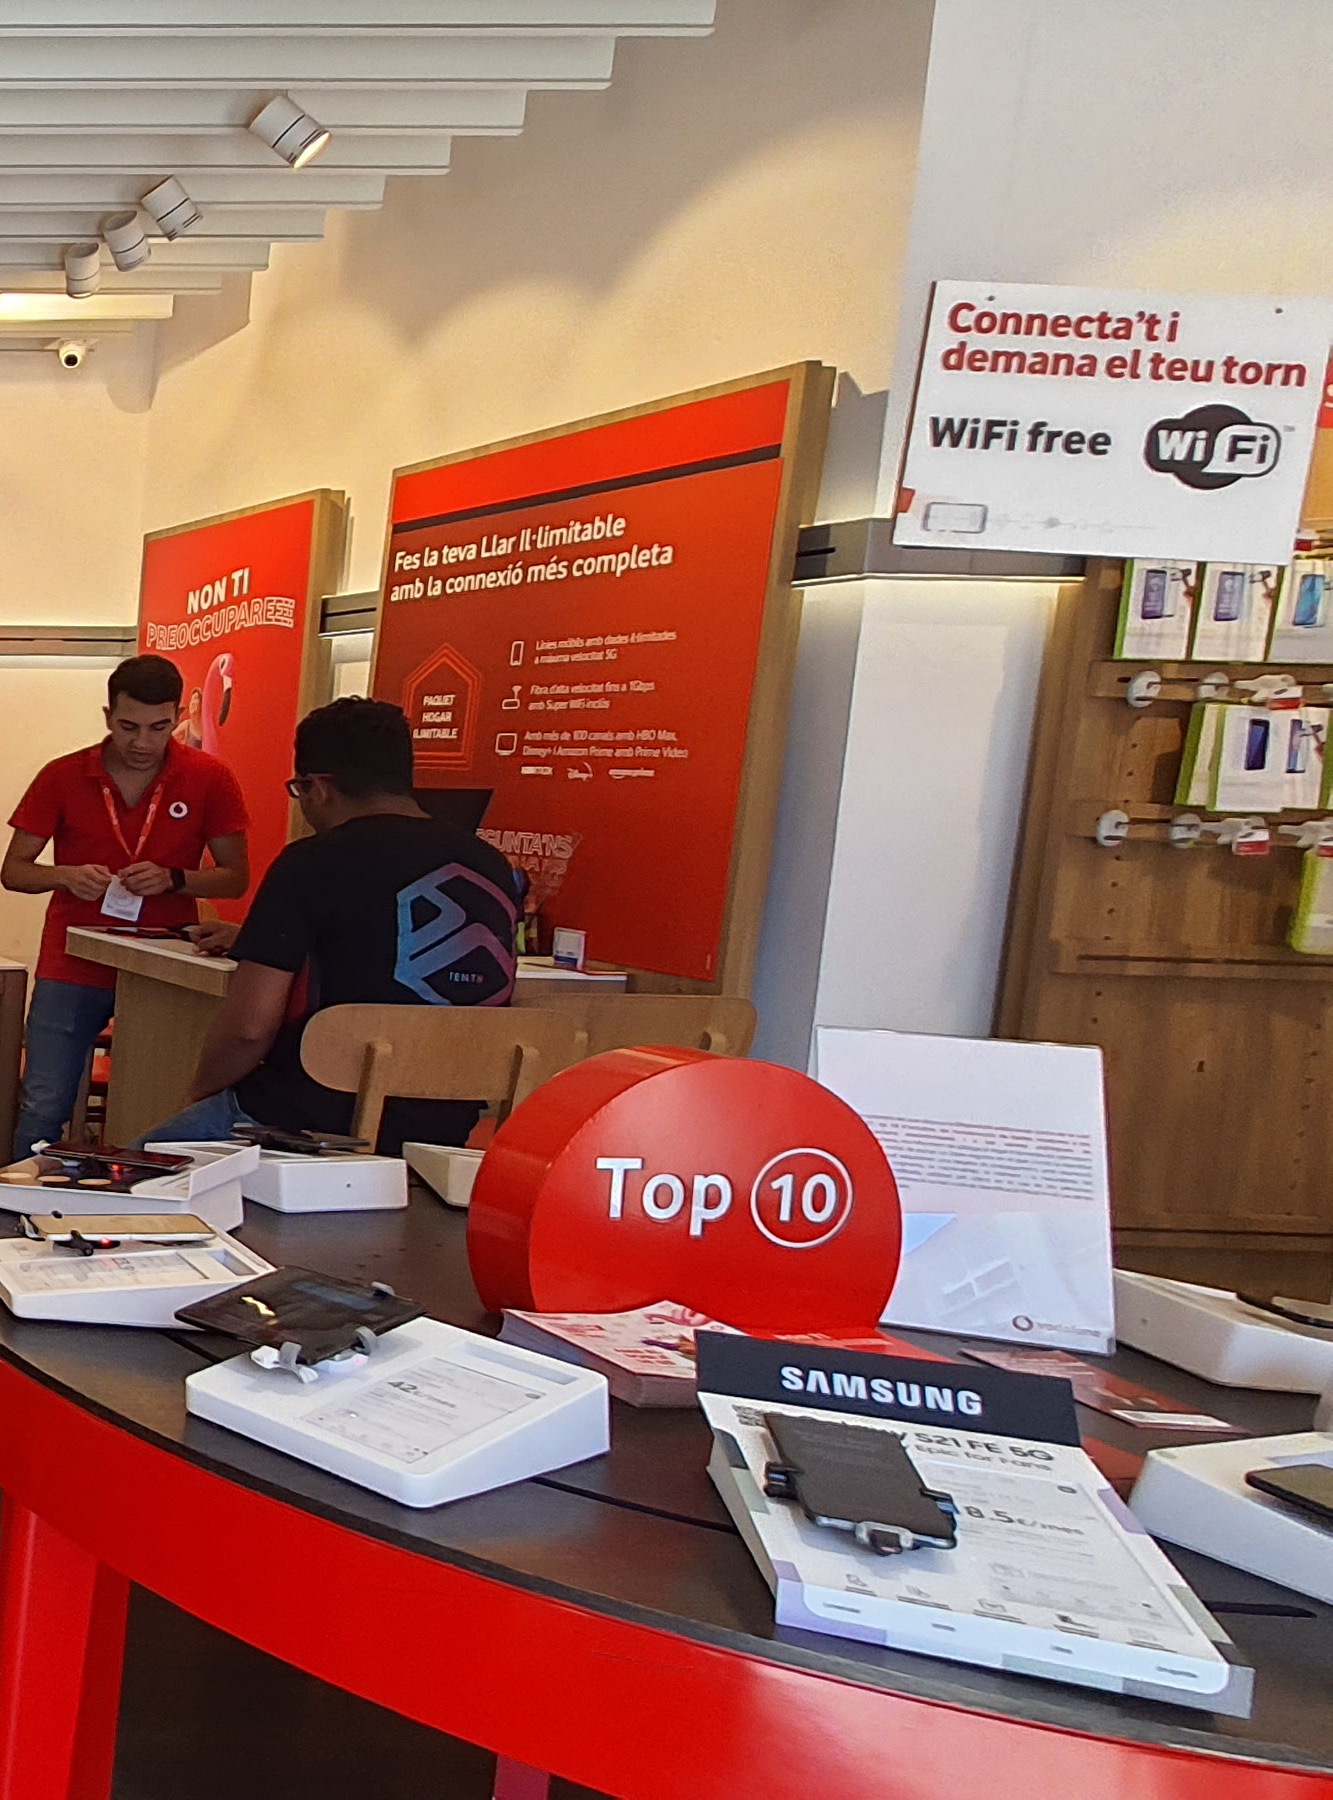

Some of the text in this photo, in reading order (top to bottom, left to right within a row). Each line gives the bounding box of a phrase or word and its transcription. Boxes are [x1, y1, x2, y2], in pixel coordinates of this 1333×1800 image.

[1166, 310, 1181, 343] i
[941, 341, 1307, 388] demana el teu torn
[930, 415, 1112, 456] WiFi free
[390, 544, 674, 601] amb la connexió més completa
[394, 551, 421, 573] Fes
[424, 547, 439, 568] la
[442, 543, 477, 564] teva
[481, 534, 517, 558] Llar
[187, 567, 250, 615] NON TI
[595, 1157, 837, 1239] Top 10
[779, 1365, 985, 1418] SAMSUNG
[914, 1432, 962, 1449] S21
[967, 1439, 1003, 1455] FE
[1009, 1445, 1055, 1462] 5G
[915, 1444, 960, 1459] Epic
[964, 1450, 993, 1464] for
